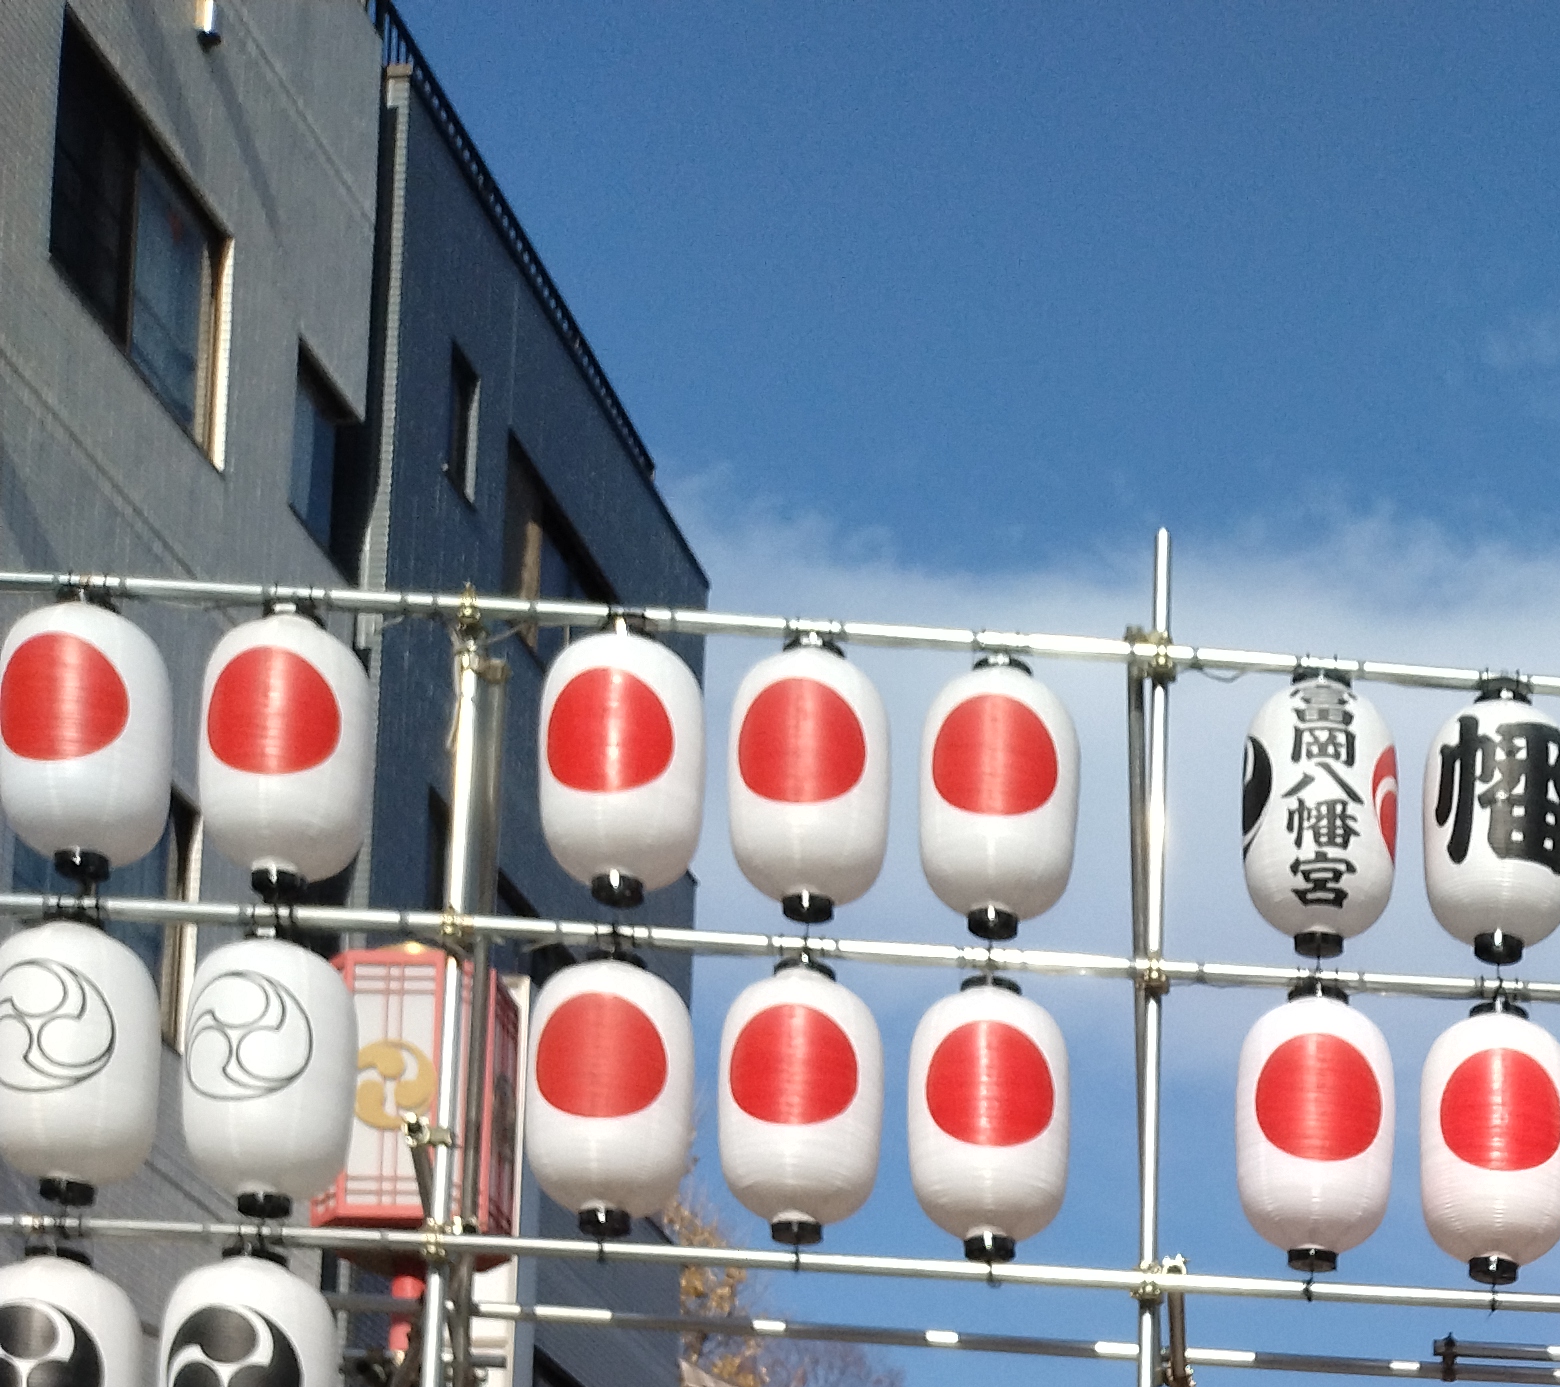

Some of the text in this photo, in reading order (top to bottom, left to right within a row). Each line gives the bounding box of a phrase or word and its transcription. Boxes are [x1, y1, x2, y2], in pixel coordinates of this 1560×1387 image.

[1281, 684, 1363, 909] 富岡八幡宮
